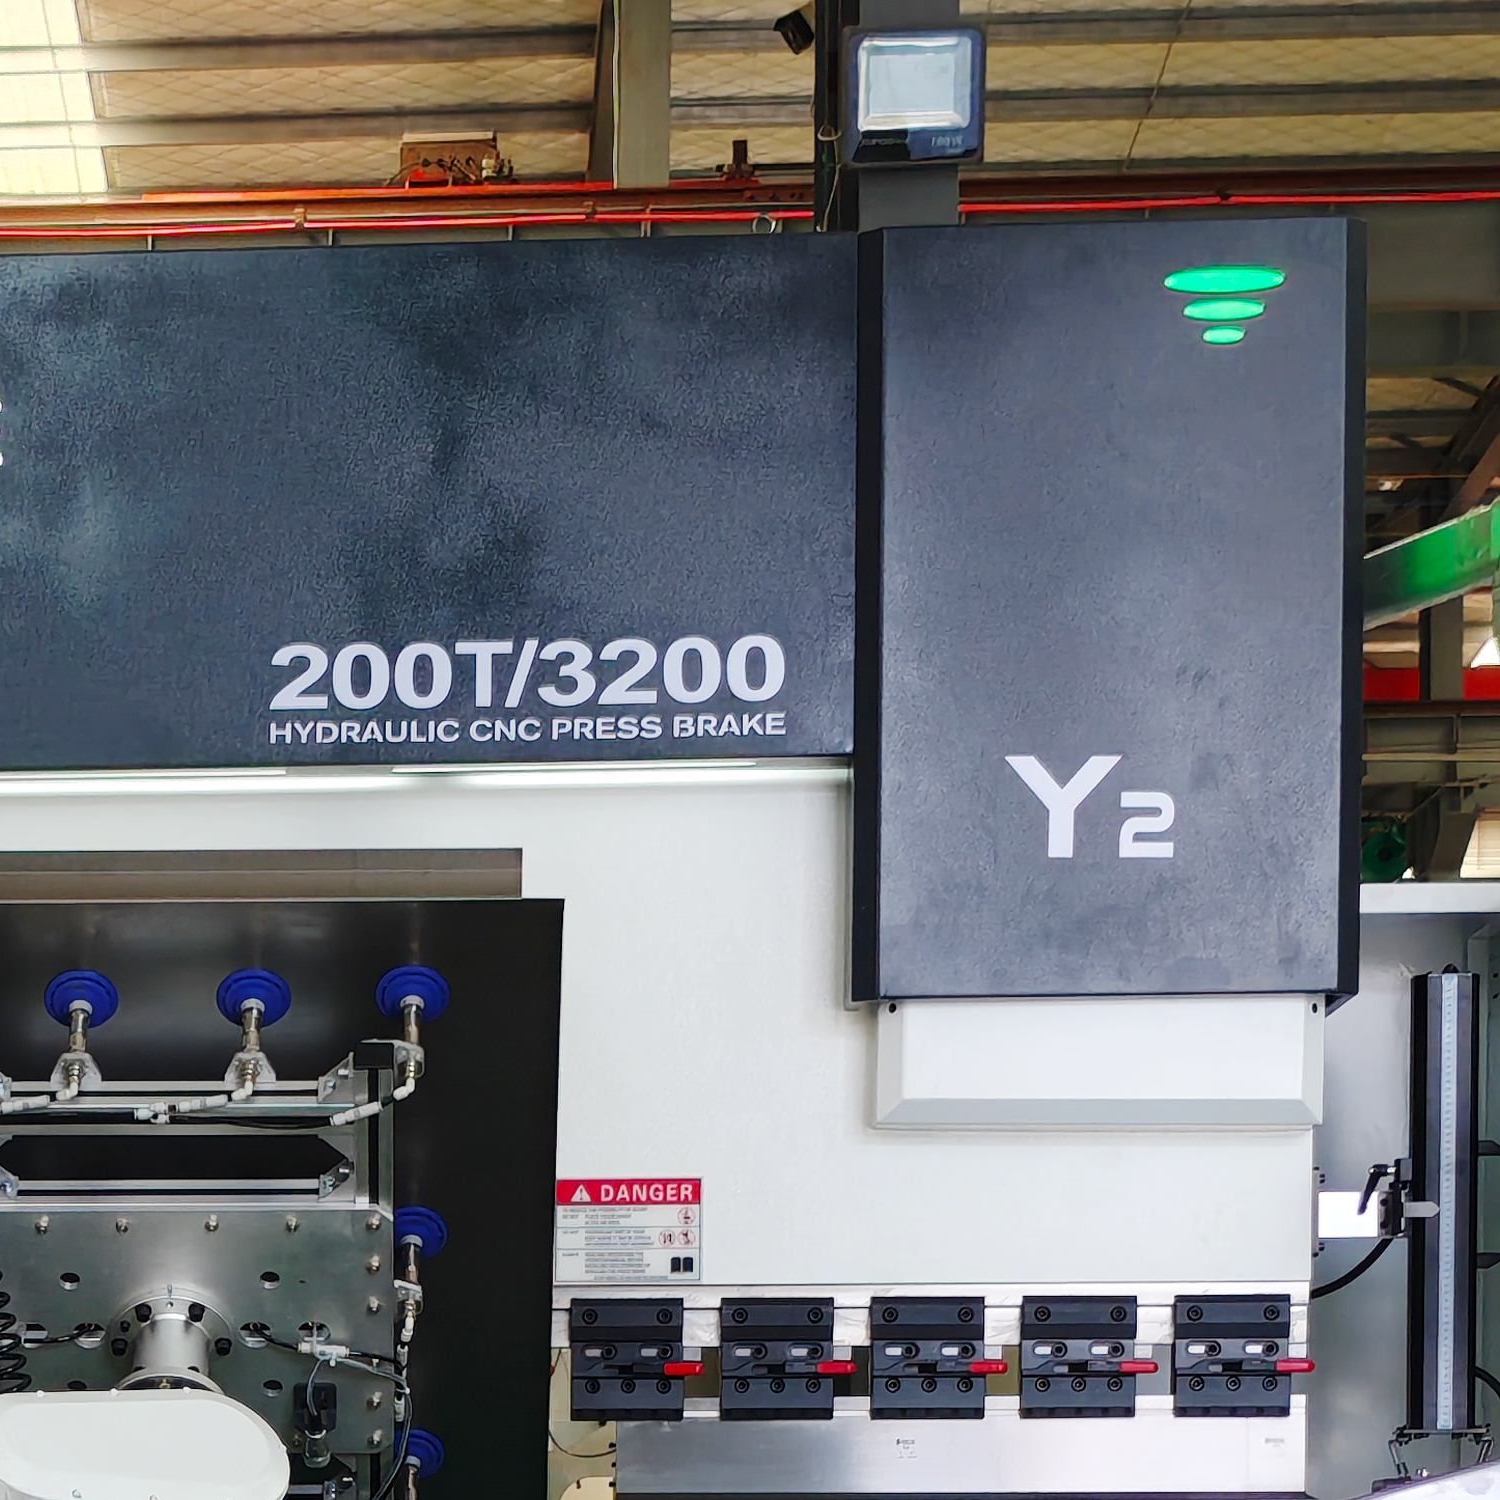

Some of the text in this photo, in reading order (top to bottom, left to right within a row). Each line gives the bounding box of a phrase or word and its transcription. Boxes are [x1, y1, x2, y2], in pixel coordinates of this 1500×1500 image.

[268, 634, 786, 710] 200T/3200
[268, 712, 788, 745] HYDRAULIC CNC PRESS BRAKE
[600, 1183, 694, 1203] DANGER
